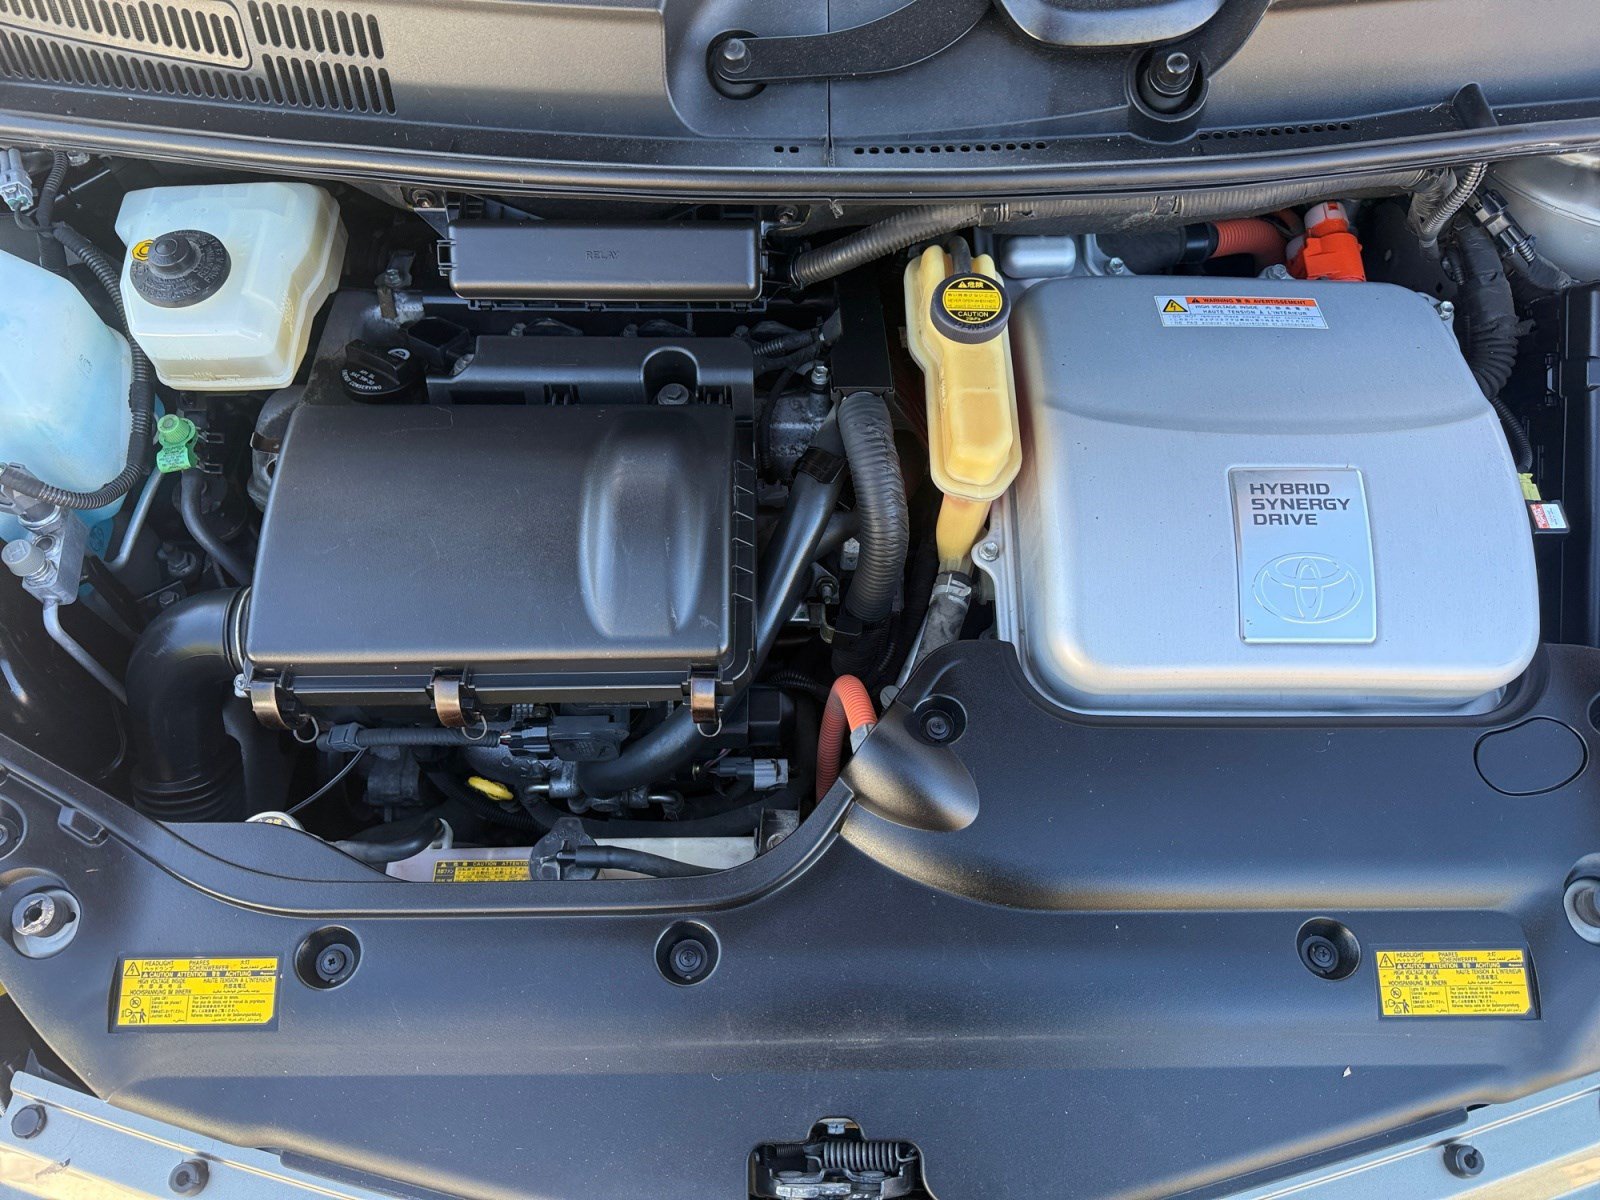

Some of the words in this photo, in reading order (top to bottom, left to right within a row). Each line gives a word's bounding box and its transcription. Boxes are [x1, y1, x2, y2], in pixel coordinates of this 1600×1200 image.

[585, 250, 619, 260] RELAY
[1249, 483, 1330, 495] HYBRID
[1251, 498, 1351, 511] SYNERGY
[1253, 513, 1318, 526] DRIVE
